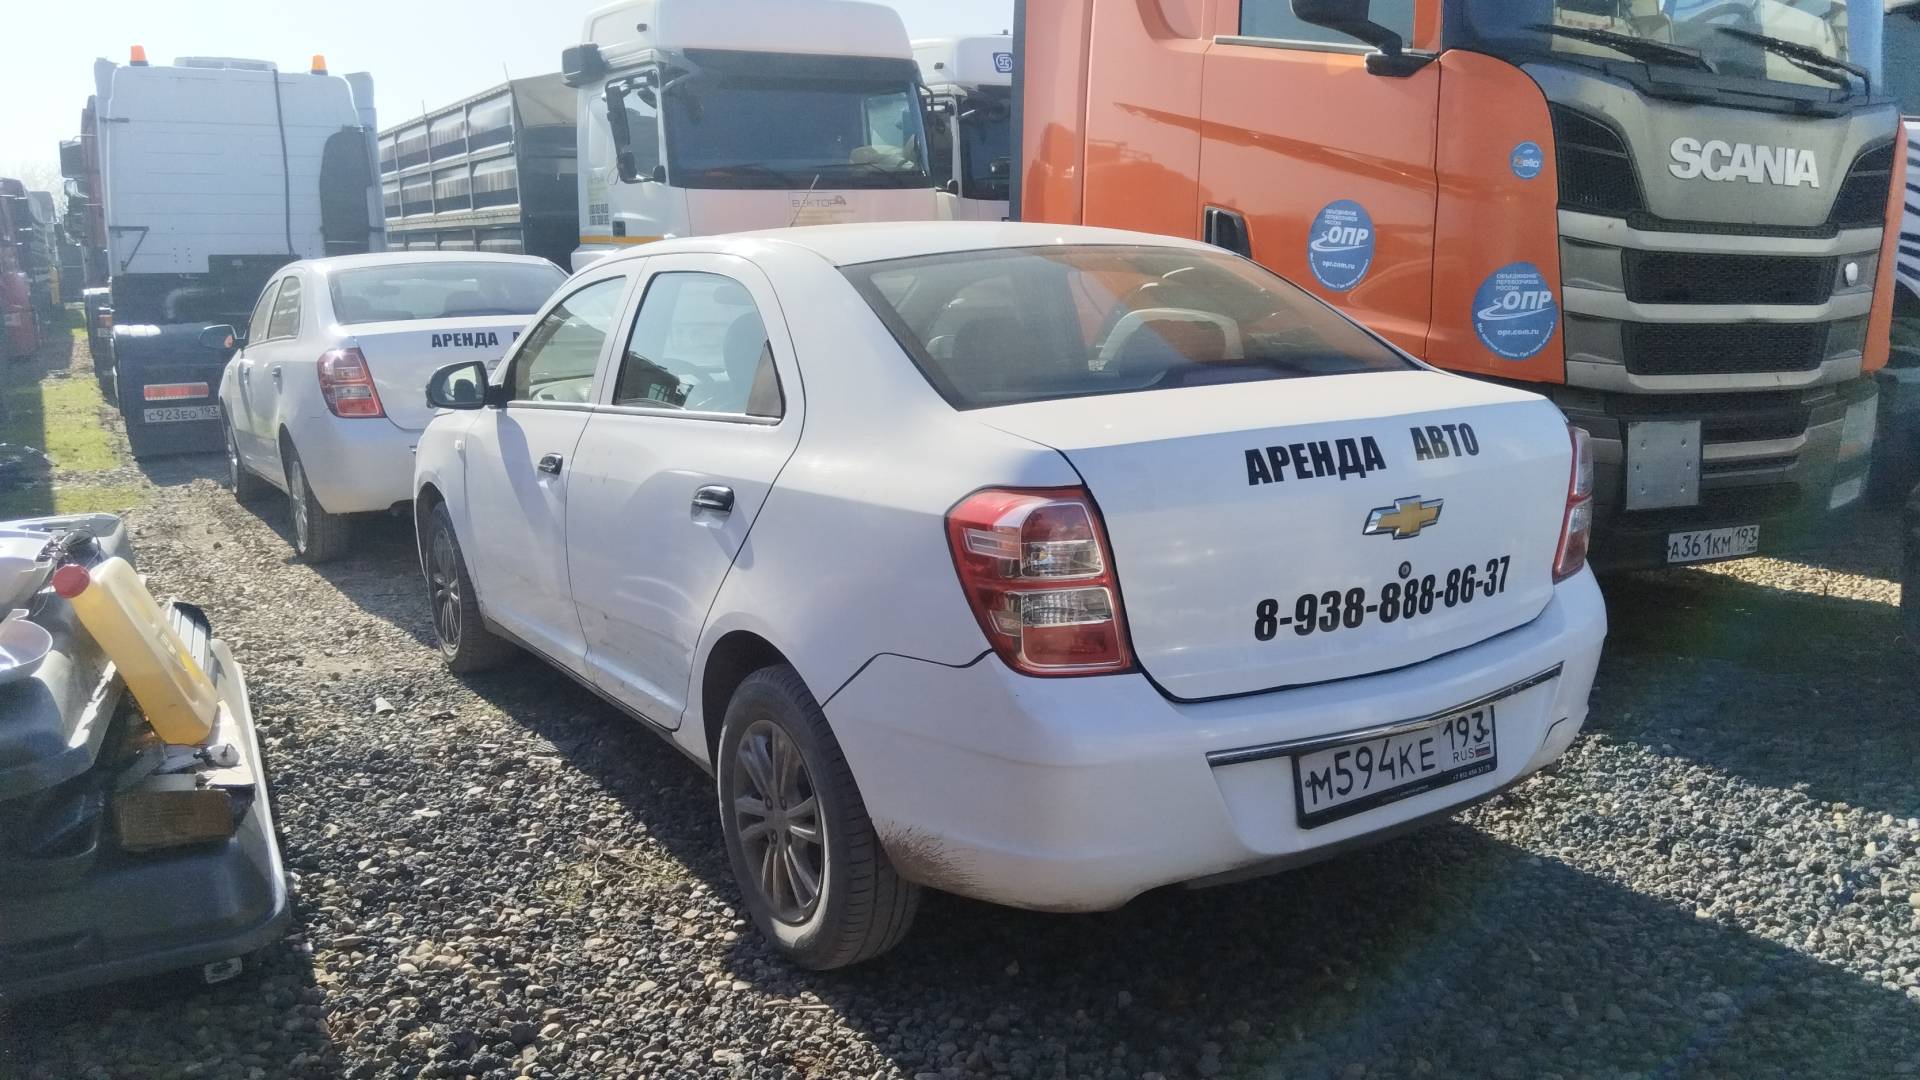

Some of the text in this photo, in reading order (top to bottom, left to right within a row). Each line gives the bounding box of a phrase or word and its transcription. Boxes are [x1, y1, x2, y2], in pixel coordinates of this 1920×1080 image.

[1669, 136, 1820, 189] SCANIA
[1328, 226, 1369, 246] ОПР
[1503, 291, 1552, 310] ОПР
[431, 332, 499, 349] АРЕНДА
[1245, 423, 1480, 486] АРЕНДА АВТО
[1735, 527, 1758, 545] 193
[1254, 555, 1511, 642] 8-938-888-86-37
[1309, 711, 1484, 805] М594КЕ 193
[1453, 749, 1476, 764] RUS
